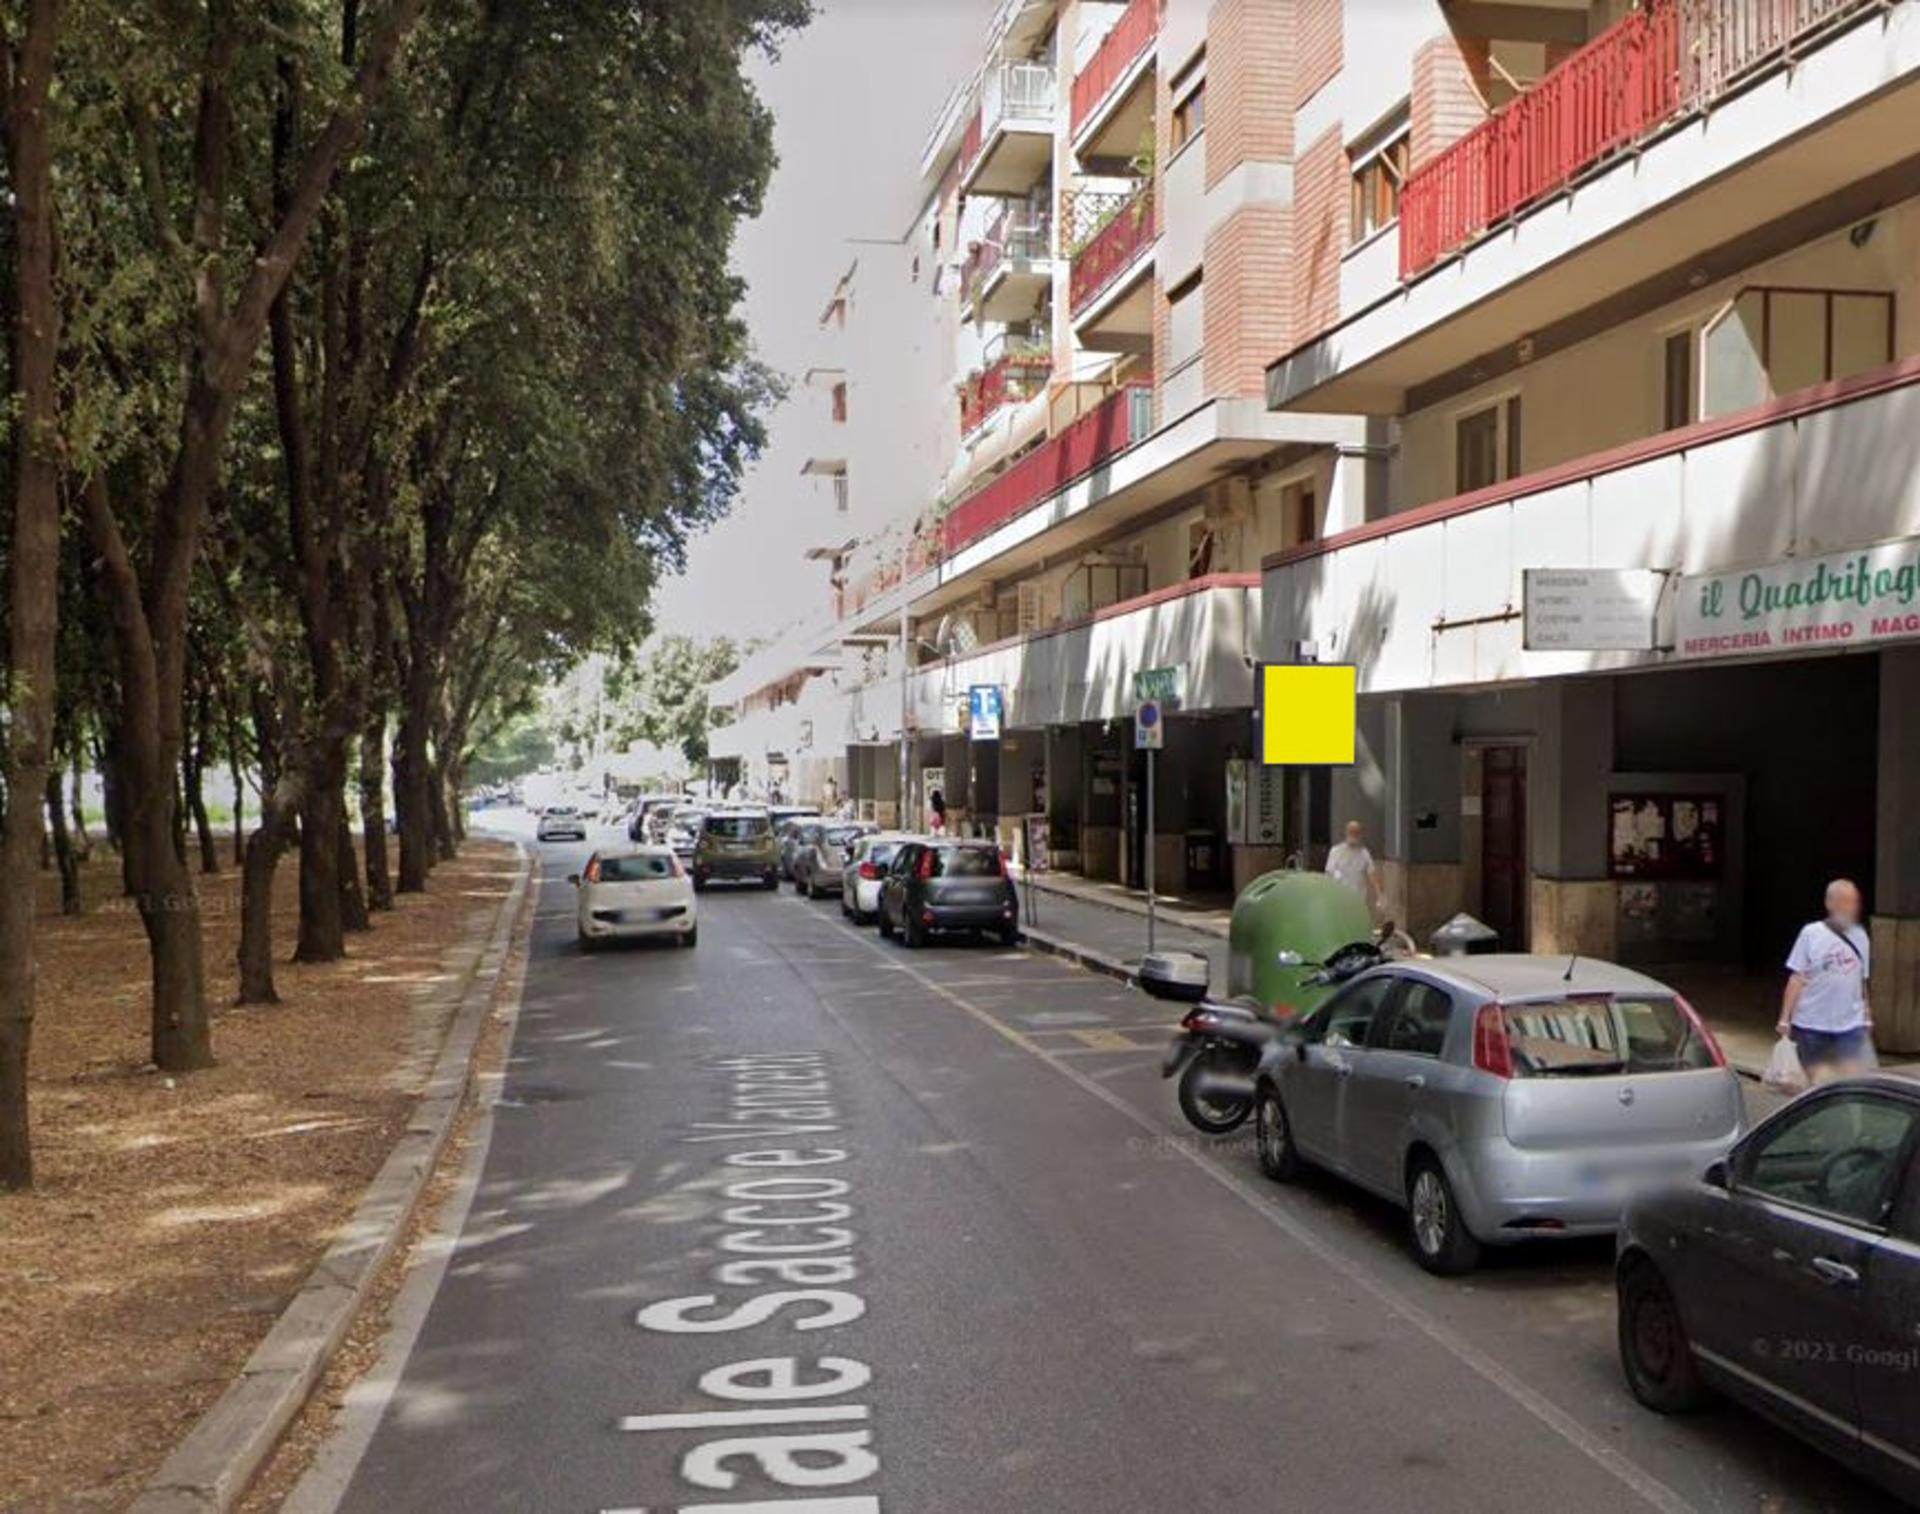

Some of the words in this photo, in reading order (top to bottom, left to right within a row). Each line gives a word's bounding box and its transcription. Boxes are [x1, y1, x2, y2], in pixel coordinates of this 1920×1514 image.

[1701, 579, 1723, 617] il
[1684, 629, 1771, 654] MERCERIA
[1782, 621, 1854, 643] INTIMO
[1871, 614, 1920, 635] MAG
[725, 1149, 847, 1167] e
[637, 1178, 866, 1333] Sacco
